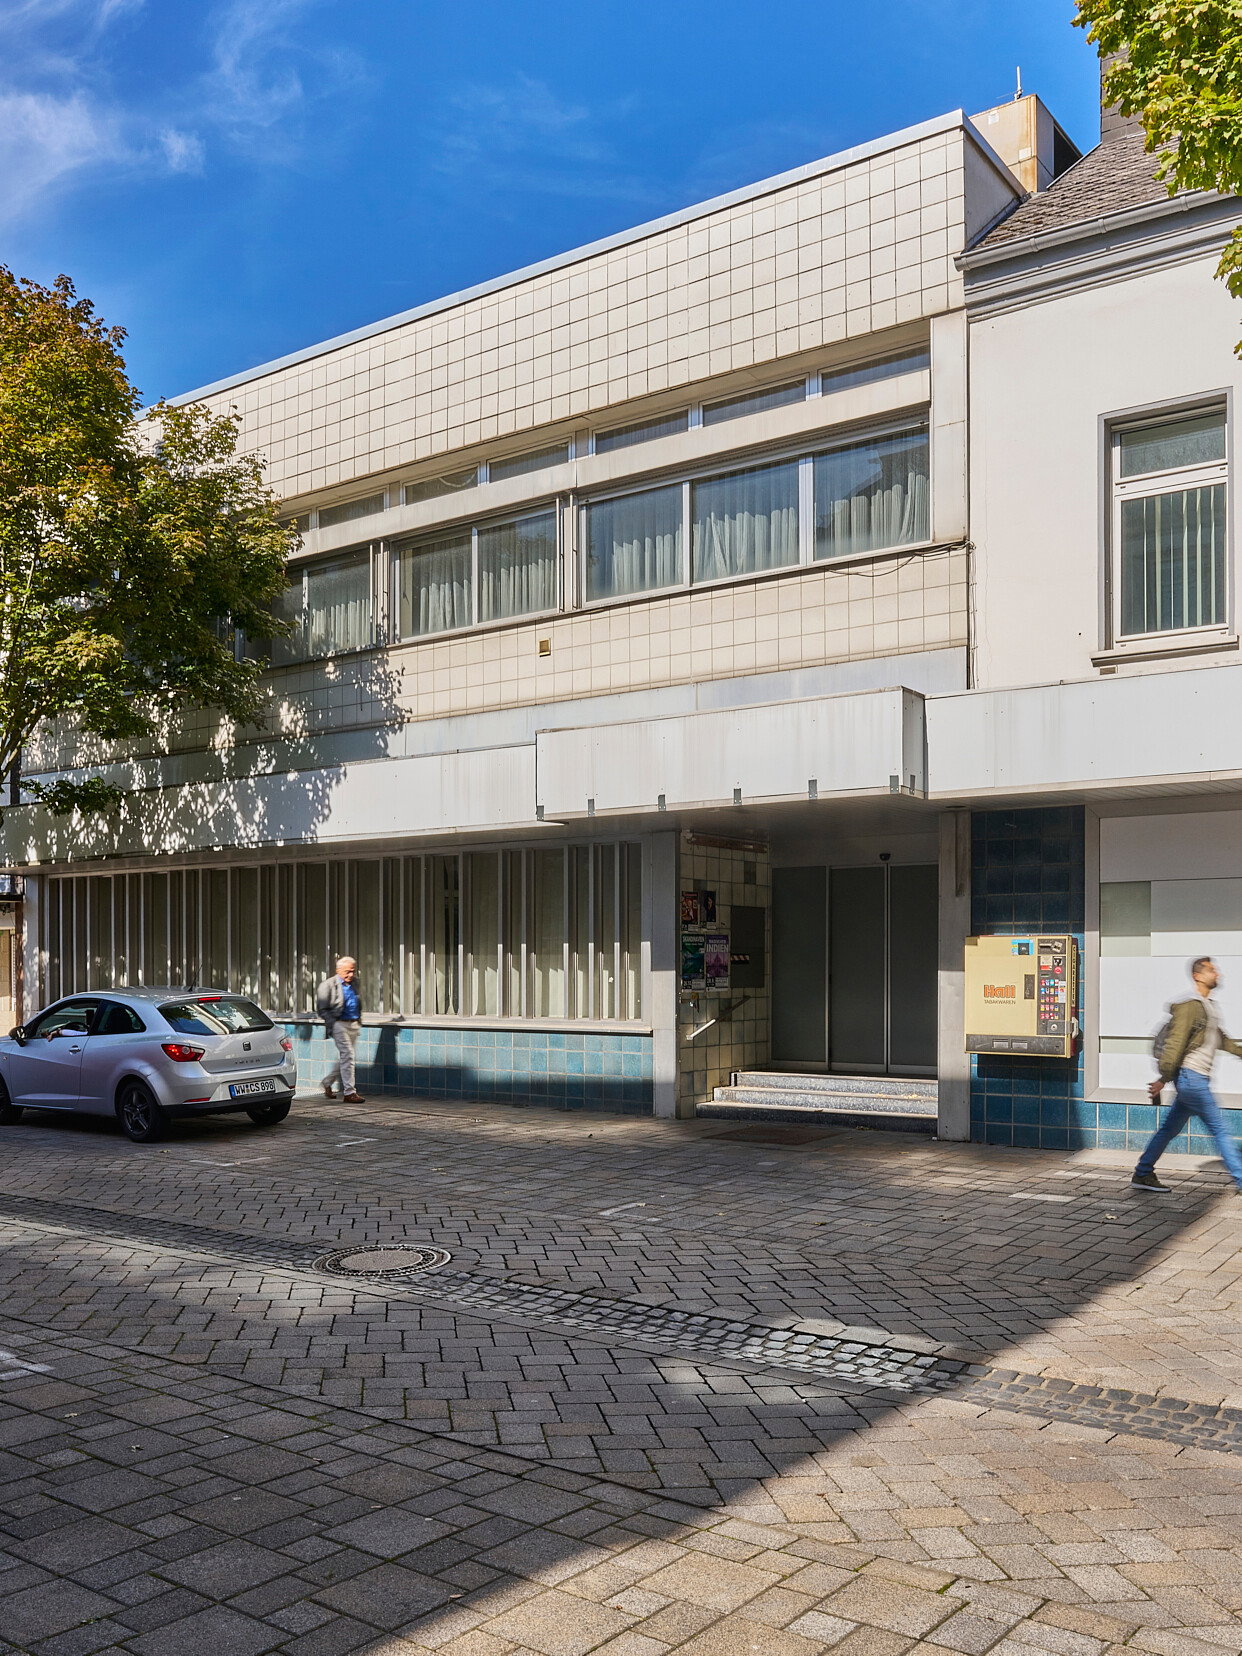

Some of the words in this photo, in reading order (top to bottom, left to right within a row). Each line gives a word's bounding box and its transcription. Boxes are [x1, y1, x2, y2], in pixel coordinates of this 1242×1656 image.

[706, 944, 729, 953] INDIEN
[984, 985, 1016, 998] Hall
[235, 1084, 246, 1095] WW
[250, 1082, 260, 1092] CS
